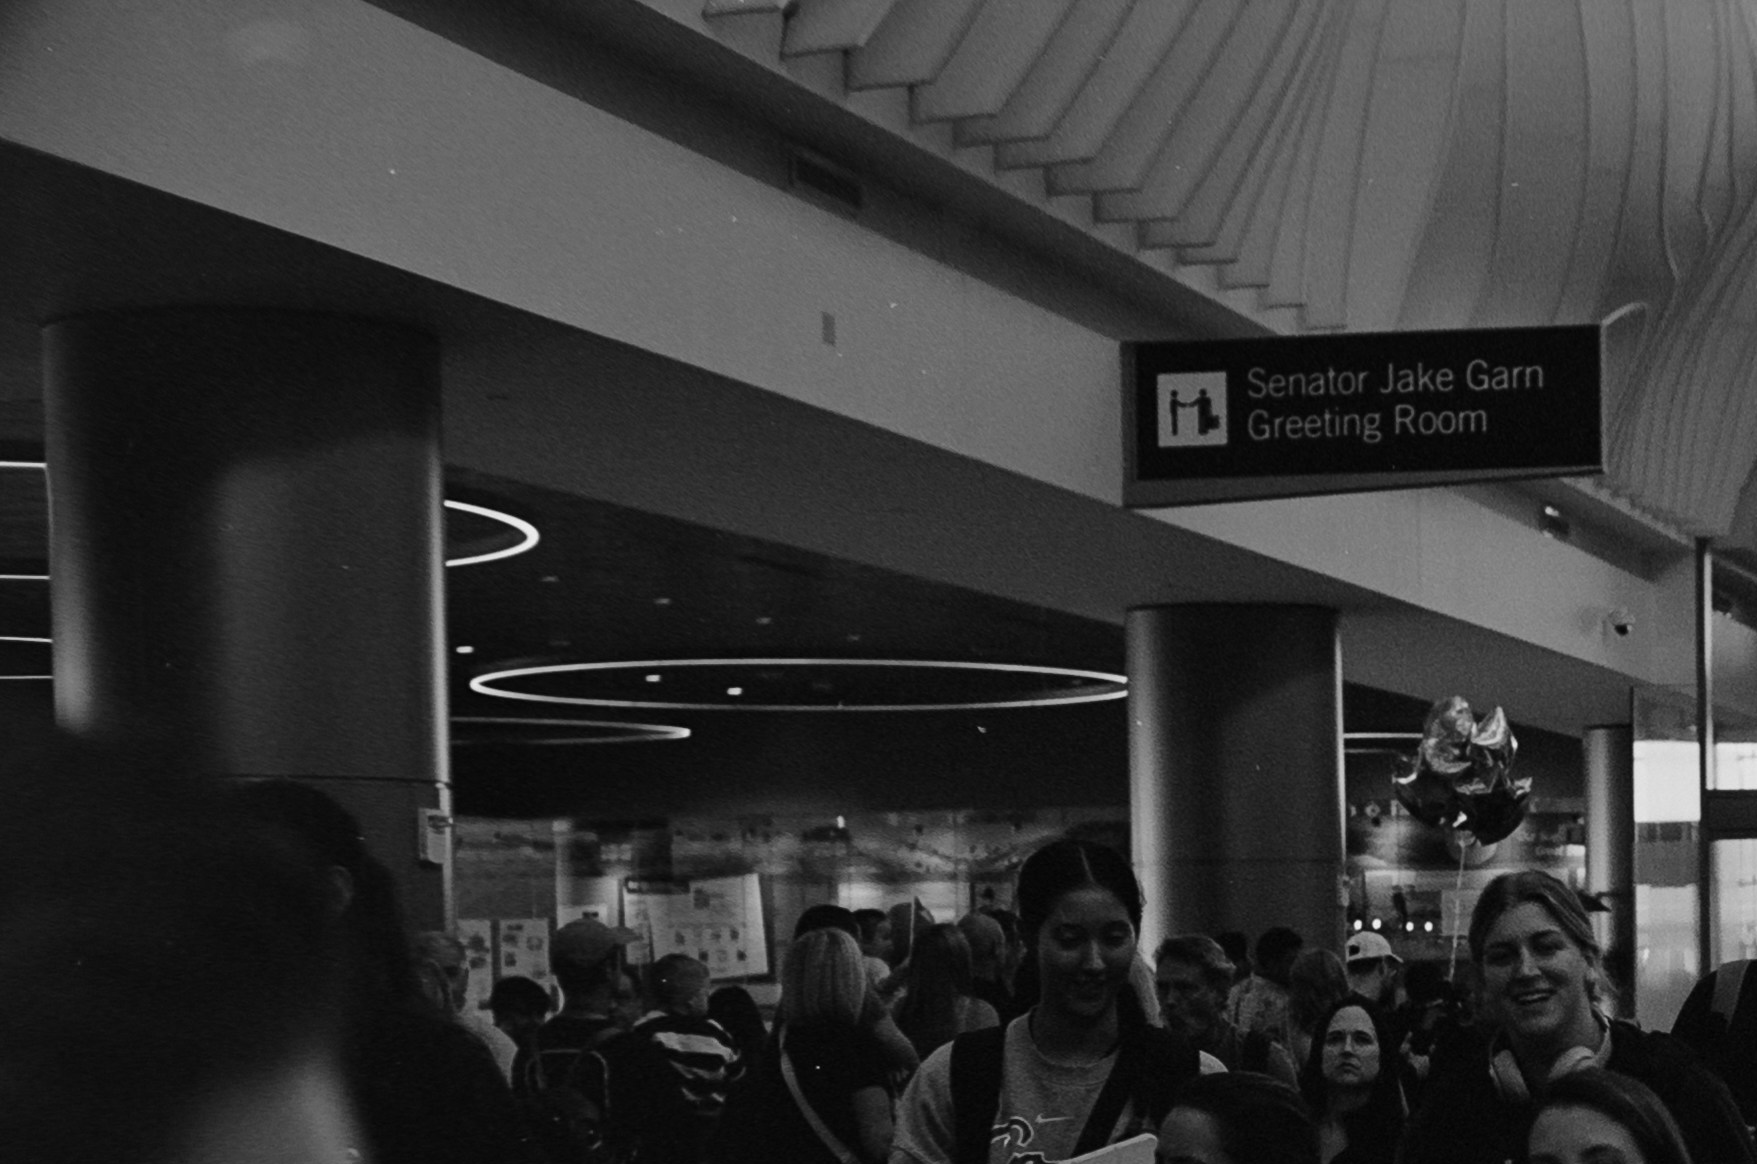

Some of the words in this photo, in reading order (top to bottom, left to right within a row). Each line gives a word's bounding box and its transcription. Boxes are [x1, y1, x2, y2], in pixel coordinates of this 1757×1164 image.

[1248, 367, 1369, 398] Senator
[1380, 361, 1454, 393] Jake
[1466, 359, 1545, 391] Garn
[1248, 406, 1382, 443] Greeting
[1394, 404, 1488, 434] Room
